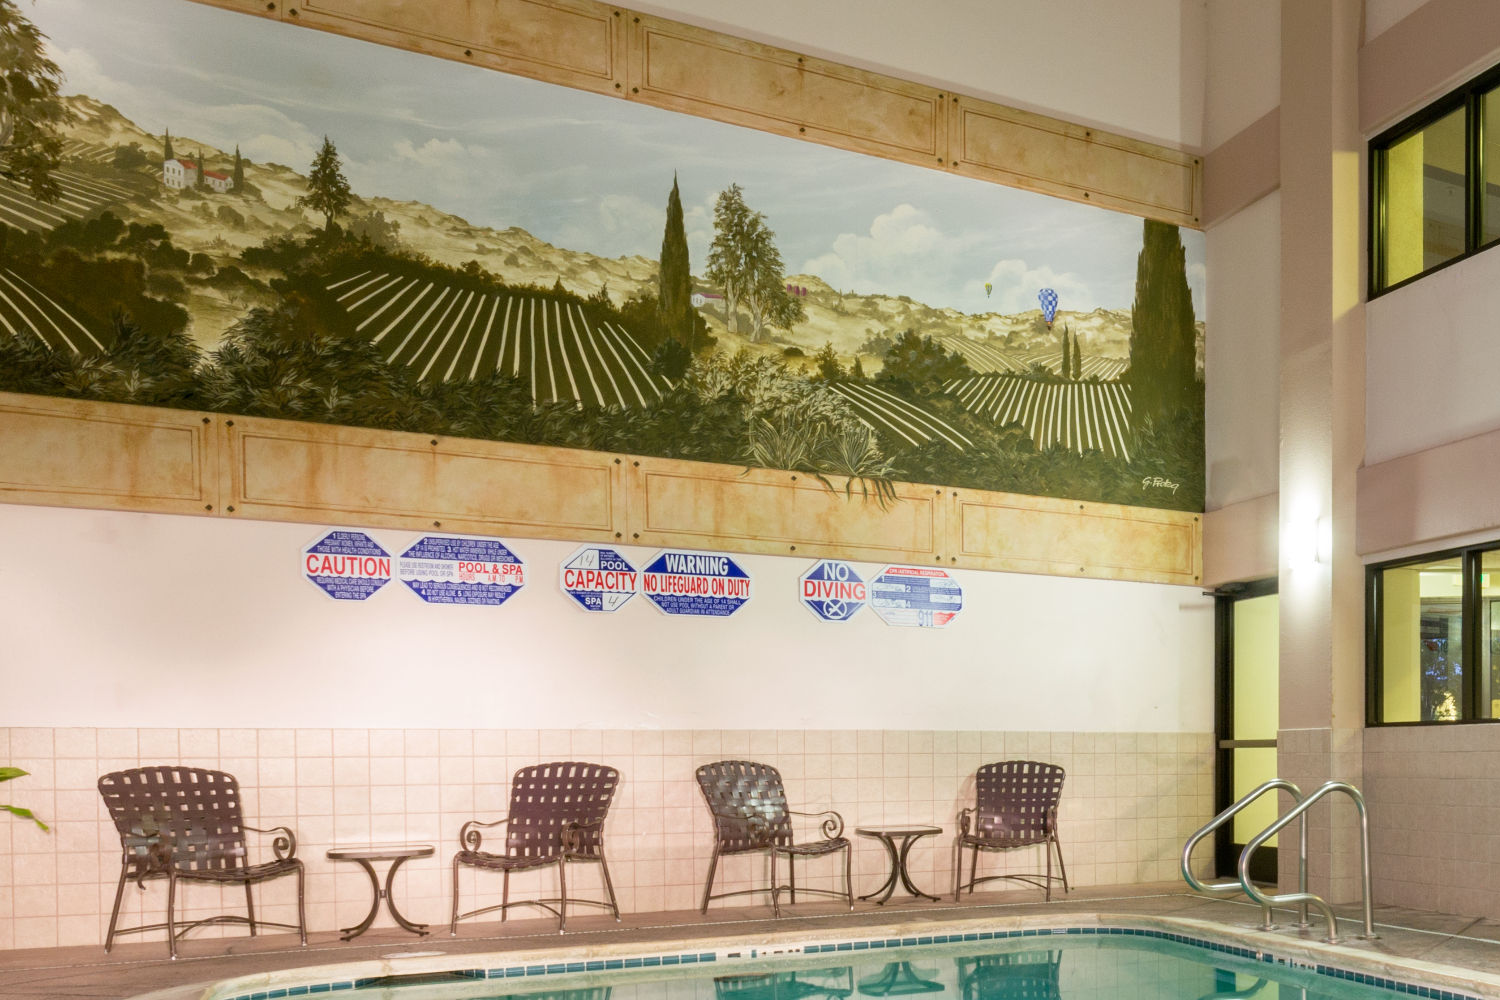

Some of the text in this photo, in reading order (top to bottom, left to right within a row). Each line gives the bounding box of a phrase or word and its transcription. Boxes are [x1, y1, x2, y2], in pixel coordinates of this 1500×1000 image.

[306, 554, 391, 576] CAUTION
[459, 562, 489, 573] POOL
[492, 564, 499, 574] &
[502, 564, 523, 575] SPA
[601, 561, 628, 571] POOL
[665, 554, 728, 575] WARNING
[823, 562, 848, 581] NO
[564, 570, 638, 590] CAPACITY
[644, 574, 750, 596] NO LIFEGUARD ON DUTY
[804, 580, 866, 600] DIVING
[919, 610, 933, 626] 911
